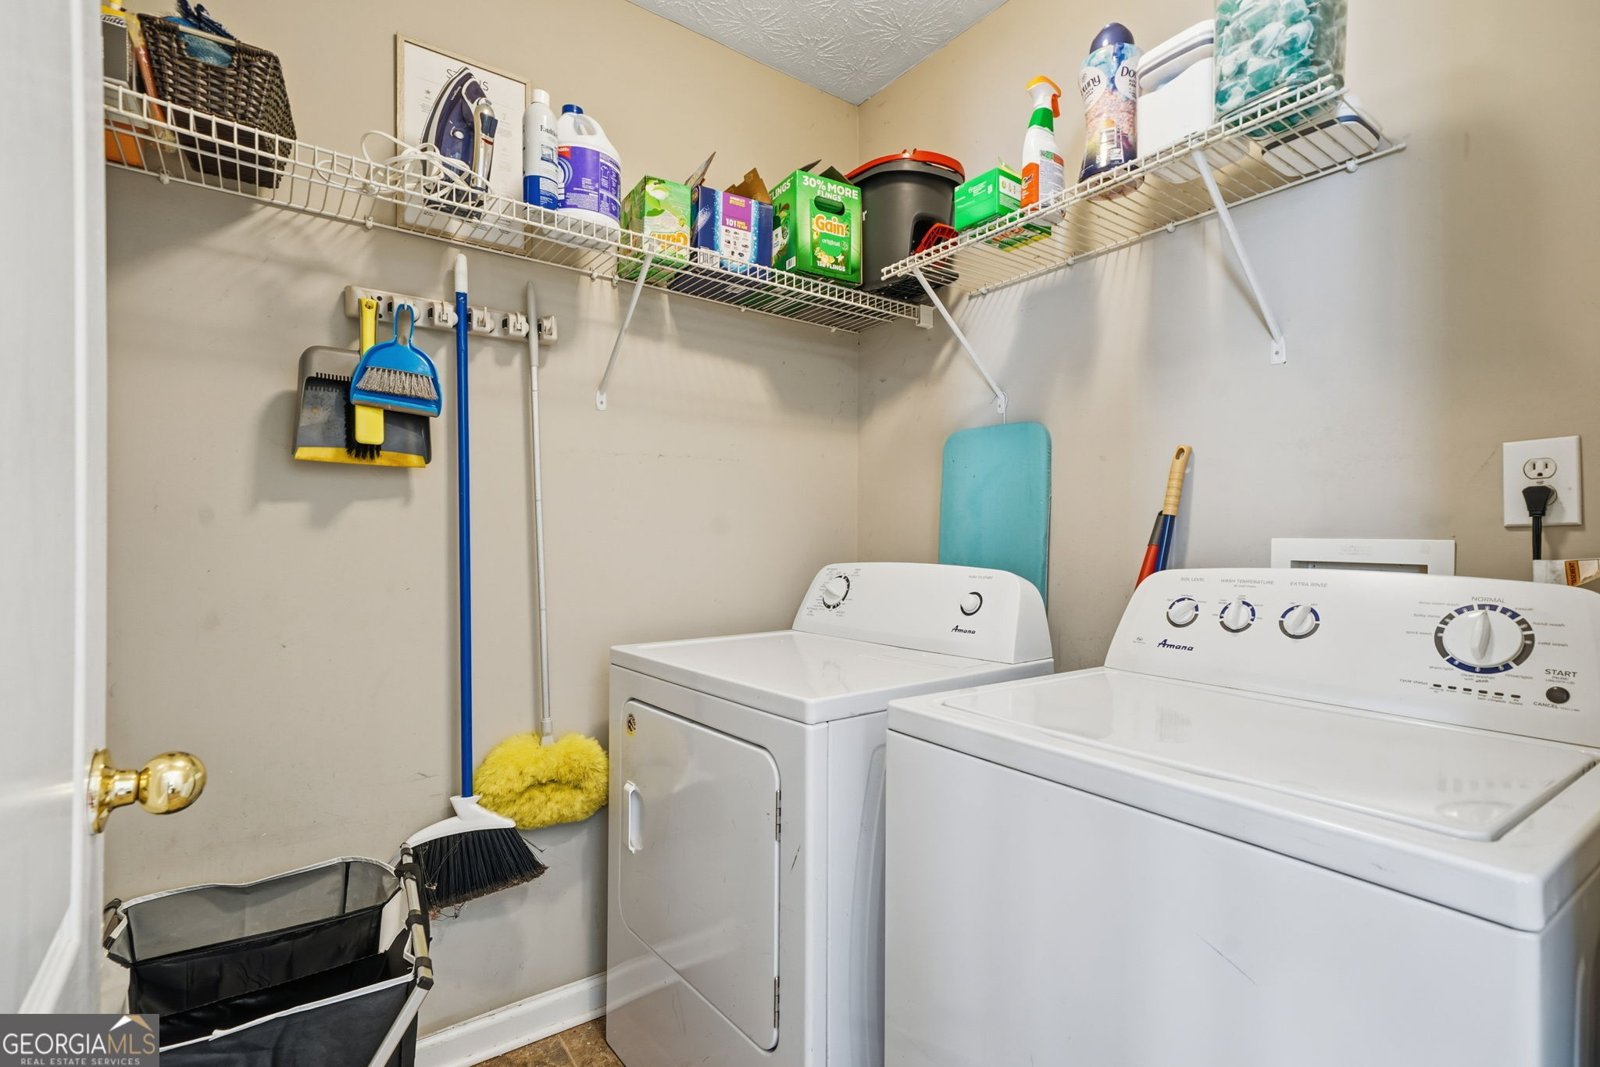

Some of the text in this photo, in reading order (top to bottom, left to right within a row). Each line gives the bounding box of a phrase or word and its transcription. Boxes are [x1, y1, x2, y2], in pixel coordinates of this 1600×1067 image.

[802, 175, 859, 200] 30% MORE
[814, 214, 846, 236] Gain
[1471, 596, 1506, 604] NORMAL
[951, 624, 977, 635] Amana
[1157, 638, 1195, 652] Amana
[1545, 668, 1578, 678] START
[1533, 701, 1560, 709] CANCEL
